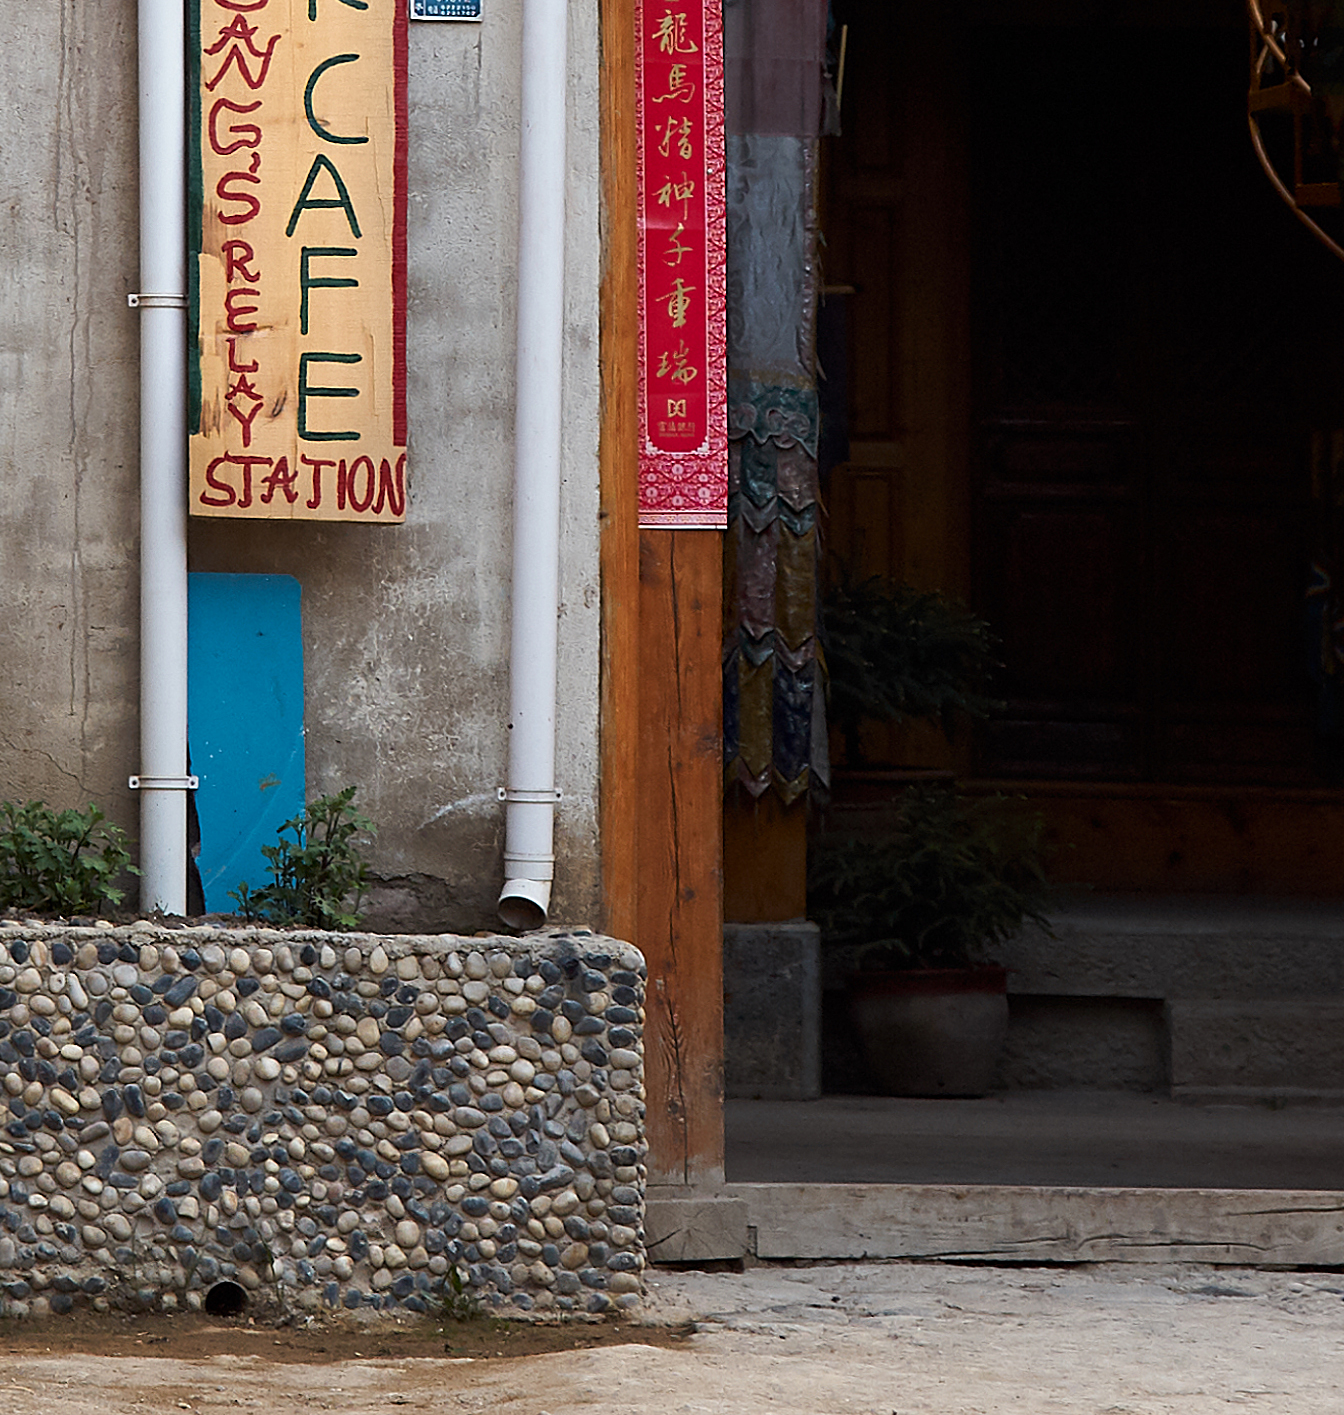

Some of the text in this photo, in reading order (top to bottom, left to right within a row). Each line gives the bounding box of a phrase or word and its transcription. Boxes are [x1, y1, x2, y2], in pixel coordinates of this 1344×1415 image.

[221, 239, 264, 448] RELAY
[285, 53, 370, 442] CAFE
[199, 451, 407, 516] STATION
